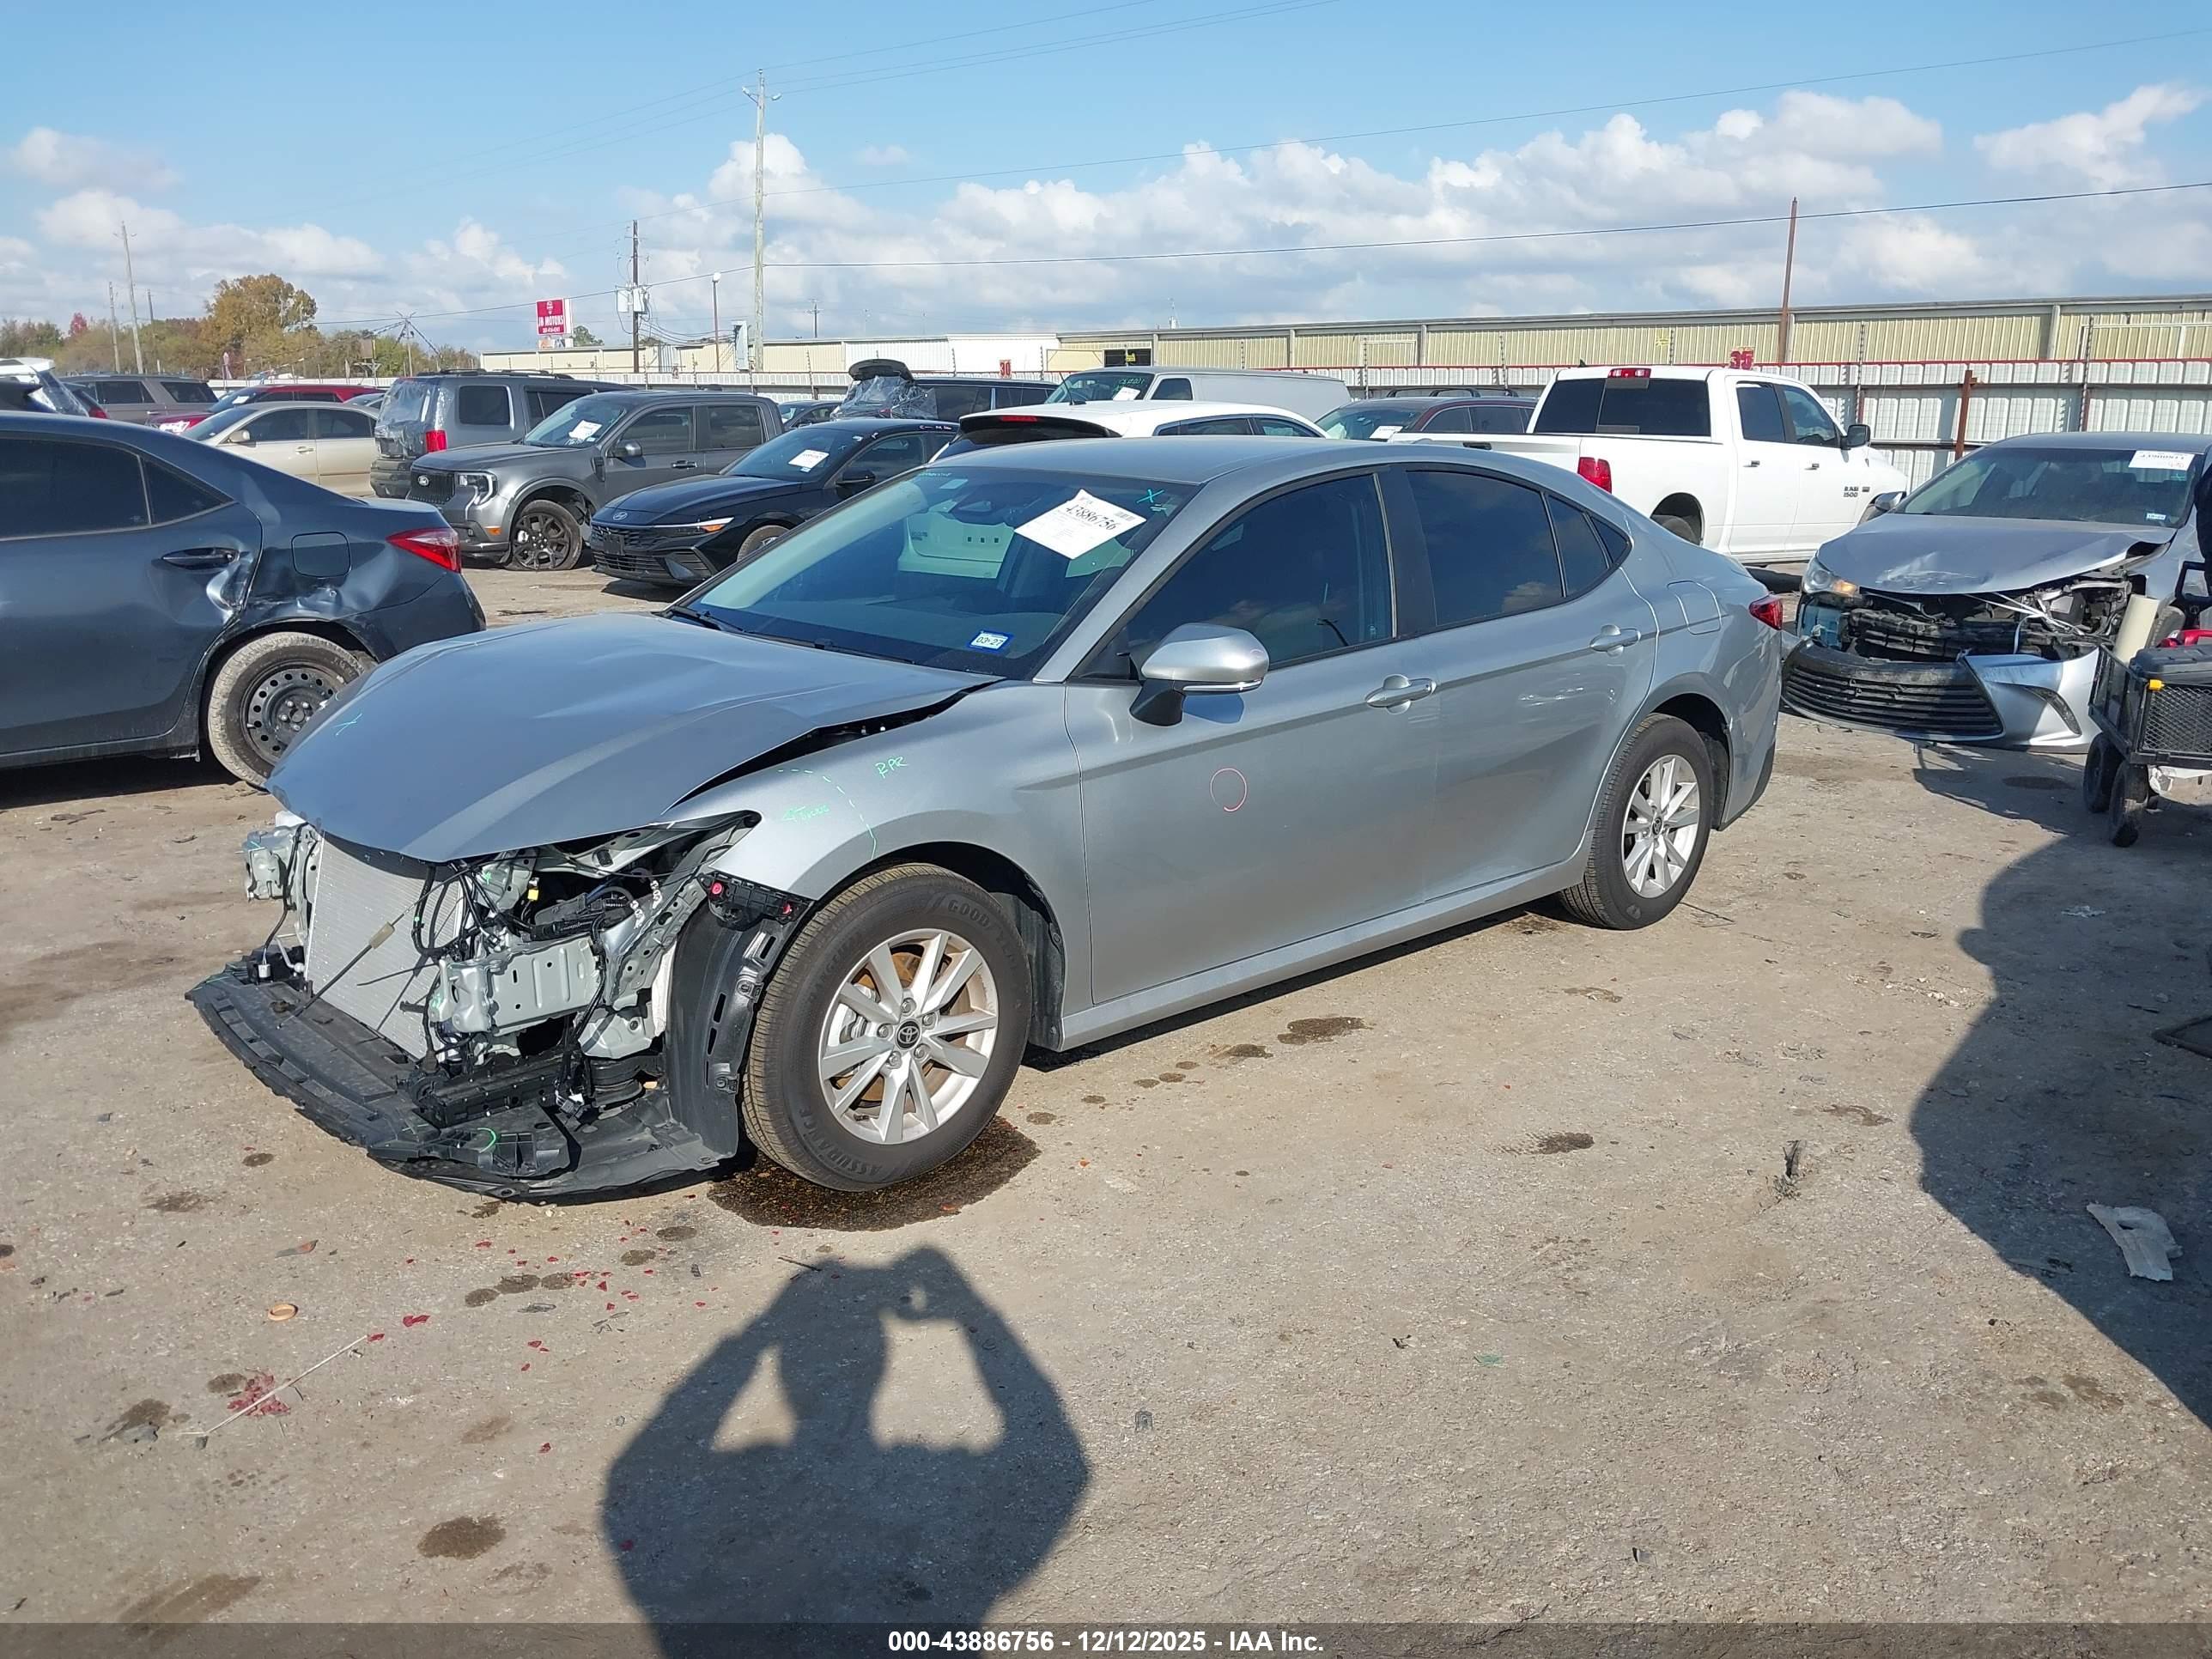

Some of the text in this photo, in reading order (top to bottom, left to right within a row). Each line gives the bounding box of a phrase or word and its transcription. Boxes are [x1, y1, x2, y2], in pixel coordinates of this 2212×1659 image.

[544, 314, 563, 325] MOTORS
[999, 361, 1011, 377] 30
[1729, 350, 1753, 370] 35
[1065, 504, 1120, 531] 43886756
